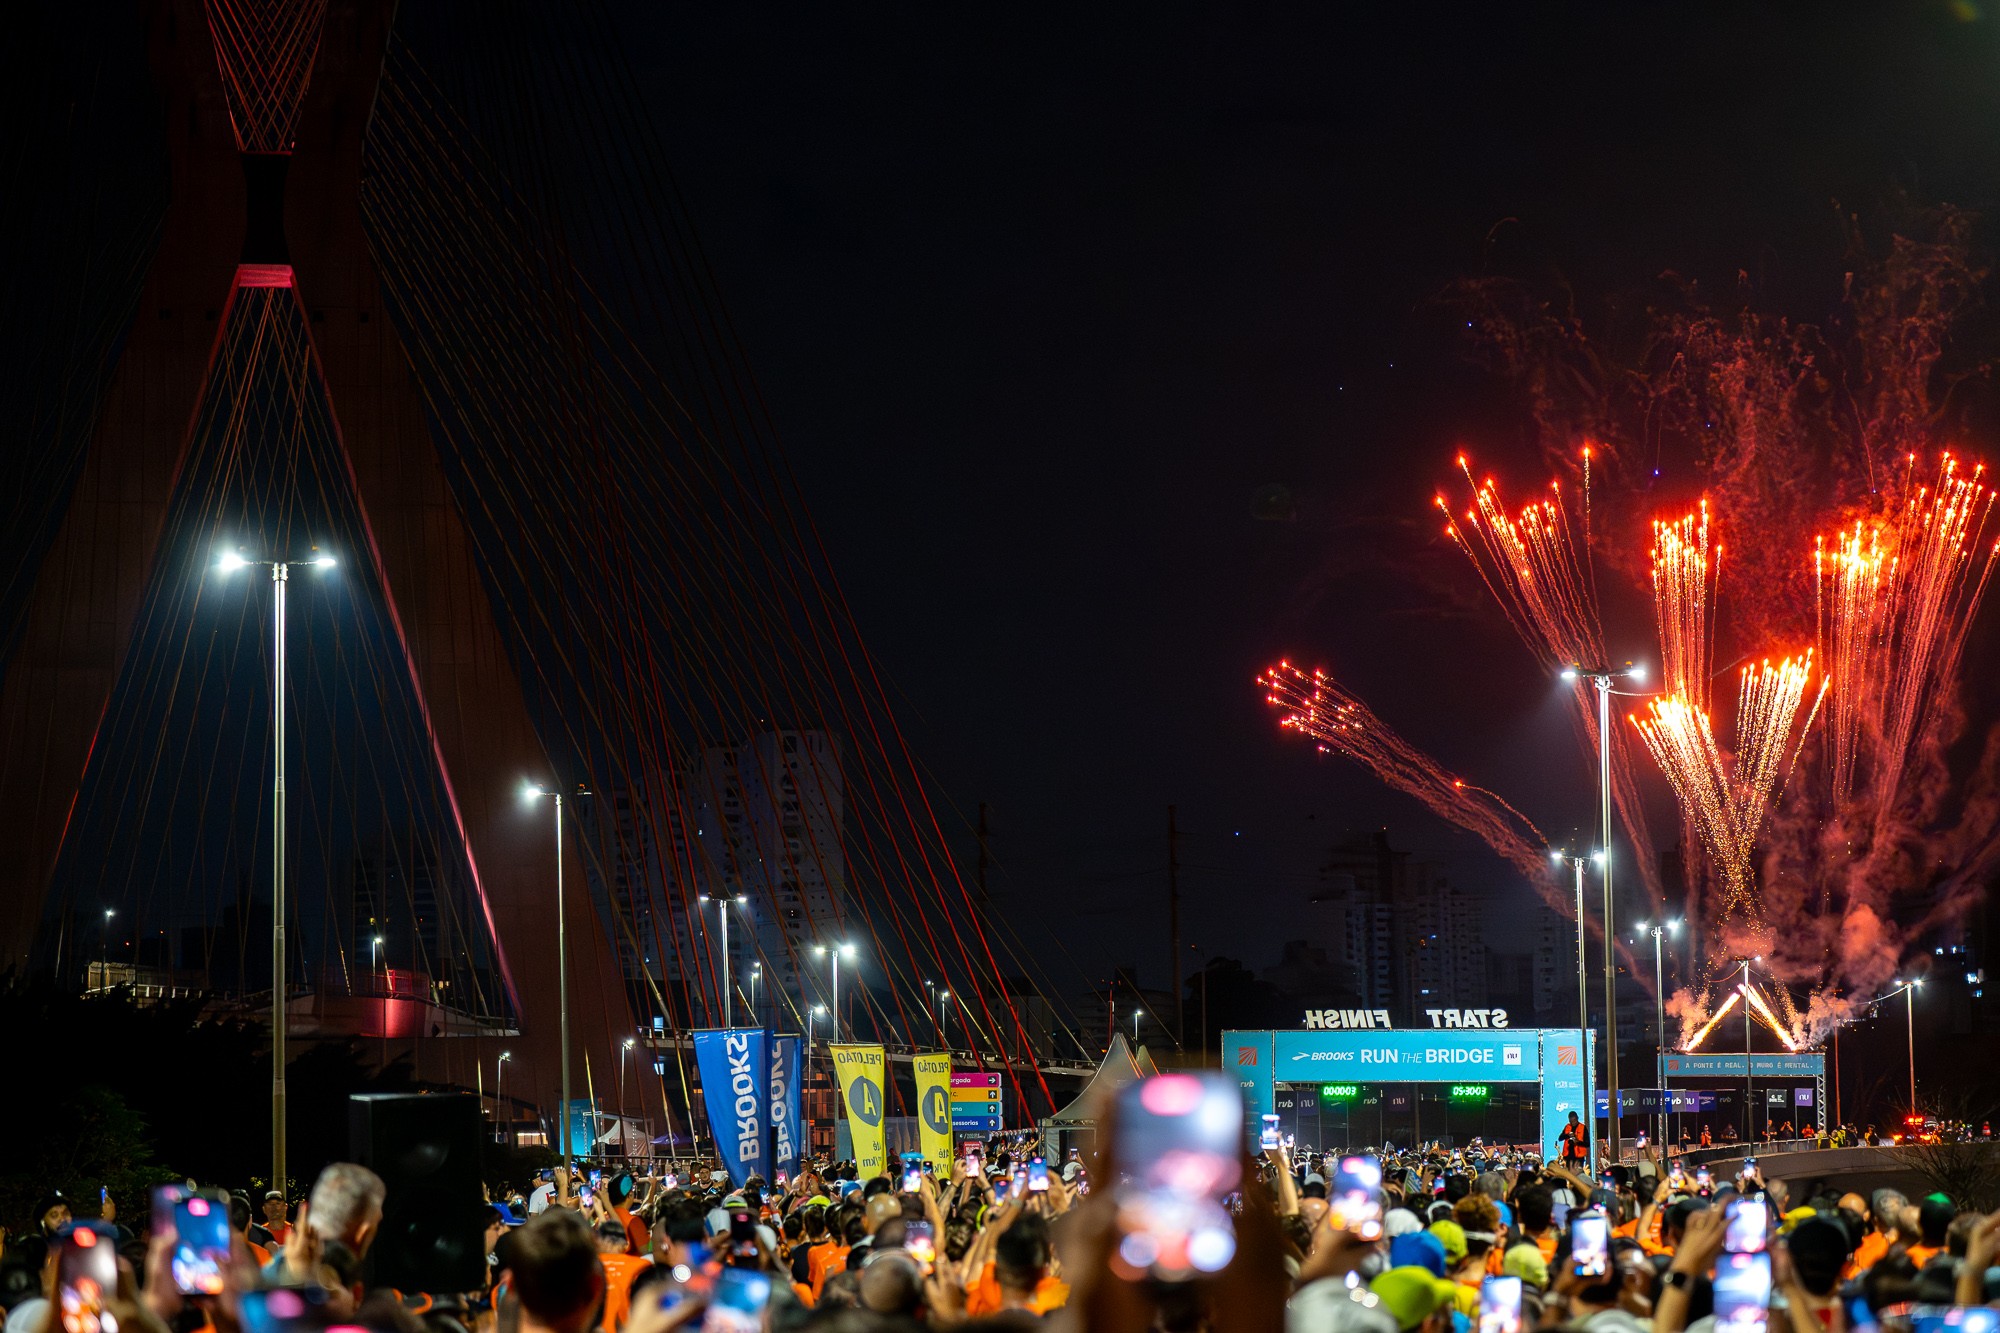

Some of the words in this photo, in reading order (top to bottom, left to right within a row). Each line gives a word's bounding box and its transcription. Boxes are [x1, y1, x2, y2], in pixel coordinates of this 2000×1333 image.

[1311, 1052, 1354, 1061] BROOKS
[1360, 1050, 1398, 1064] RUN
[1402, 1052, 1423, 1063] THE
[1426, 1049, 1494, 1063] BRIDGE
[1278, 1100, 1293, 1108] rvb
